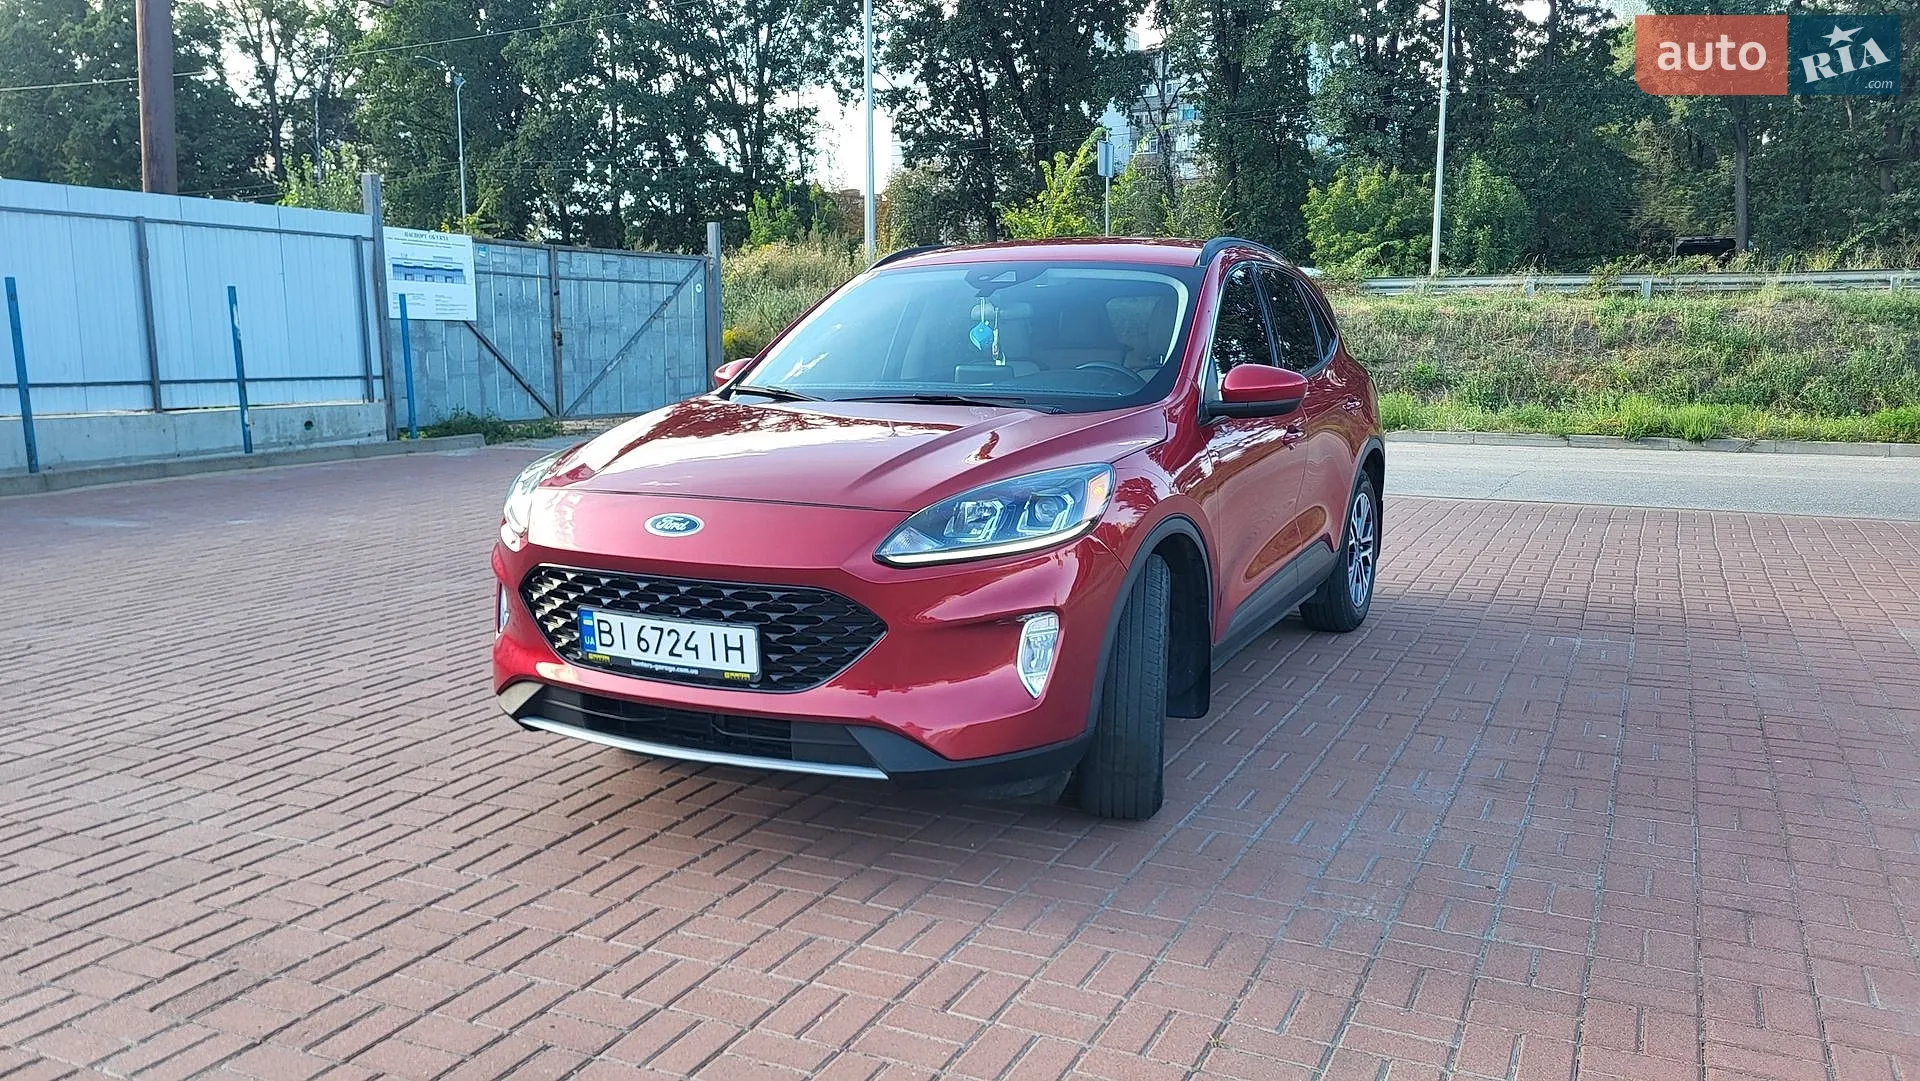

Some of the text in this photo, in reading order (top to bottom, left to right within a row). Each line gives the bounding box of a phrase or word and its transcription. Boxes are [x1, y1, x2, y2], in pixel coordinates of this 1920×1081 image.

[656, 516, 688, 531] Ford
[584, 636, 595, 646] UA
[597, 619, 745, 664] BI 6724 IH
